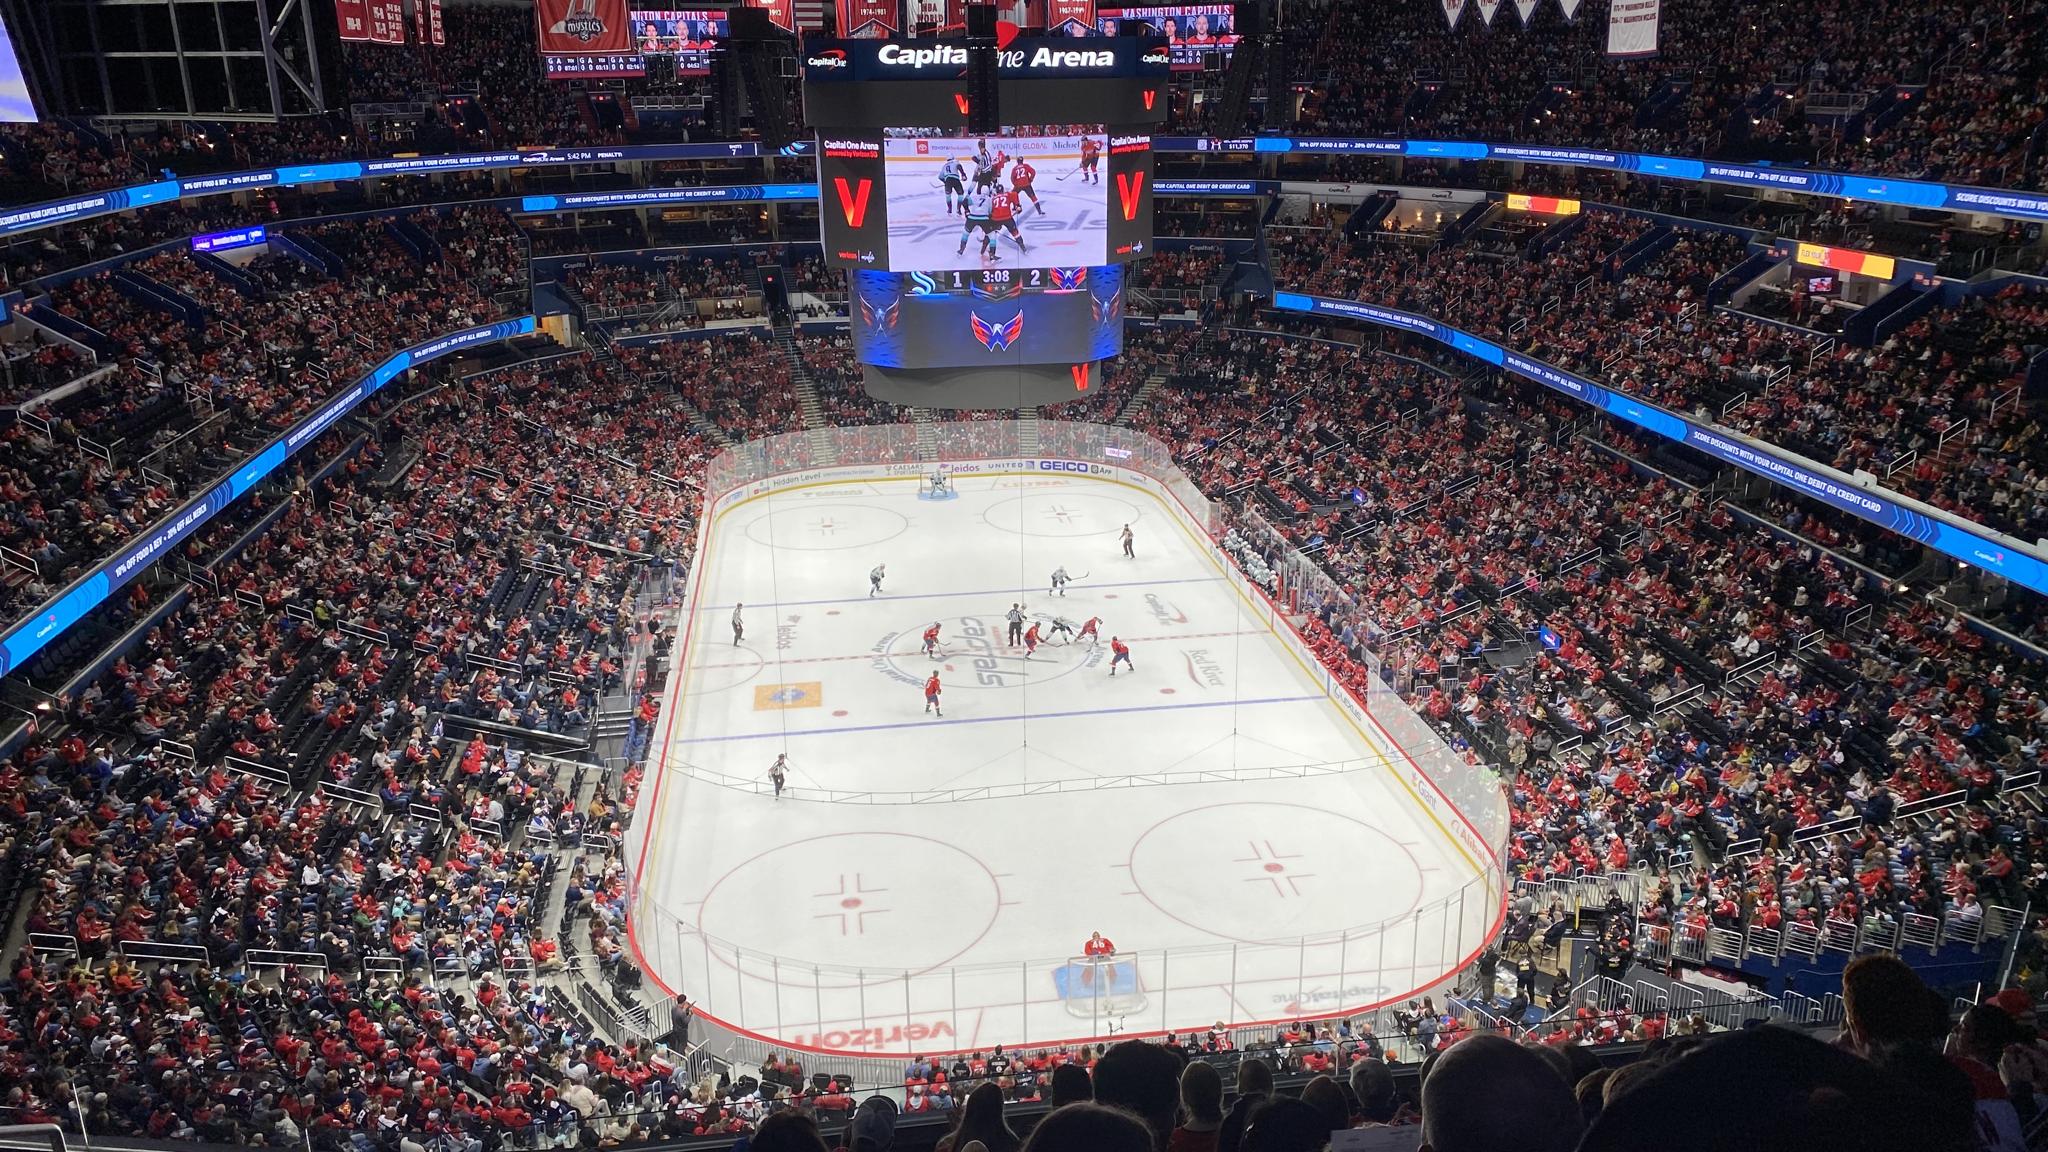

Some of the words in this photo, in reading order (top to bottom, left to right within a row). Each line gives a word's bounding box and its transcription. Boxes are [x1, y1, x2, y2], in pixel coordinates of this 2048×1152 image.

[664, 11, 708, 20] CAPITALS
[1122, 6, 1182, 18] WASHINGTON
[1185, 4, 1230, 16] CAPITALS
[878, 44, 967, 68] Capita
[1030, 48, 1113, 67] Arena
[847, 141, 859, 150] One
[860, 142, 878, 150] Arena
[834, 177, 872, 228] V
[1116, 171, 1144, 220] V
[953, 271, 961, 287] 1
[982, 270, 1009, 283] 3:08
[1031, 270, 1040, 285] 2
[952, 464, 980, 473] leidos
[1040, 460, 1088, 472] GEICO
[1694, 431, 1710, 444] SCORE
[1710, 436, 1739, 456] DISCOUNTS
[1739, 448, 1754, 462] WITH
[1754, 453, 1770, 468] YOUR
[1770, 460, 1794, 478] CAPITAL
[1794, 471, 1808, 484] ONE
[1808, 475, 1826, 491] DEBIT
[1827, 484, 1836, 494] OR
[1837, 486, 1861, 504] CREDIT
[1862, 497, 1881, 513] CARD
[773, 475, 799, 487] Hidden
[800, 472, 822, 482] Level
[126, 555, 136, 569] OFF
[177, 519, 185, 532] OFF
[185, 514, 193, 526] ALL
[1189, 649, 1216, 666] Red
[1200, 663, 1225, 687] River
[1418, 780, 1437, 810] Giant
[1273, 986, 1391, 1003] CapitalOne
[794, 1020, 954, 1049] verizon
